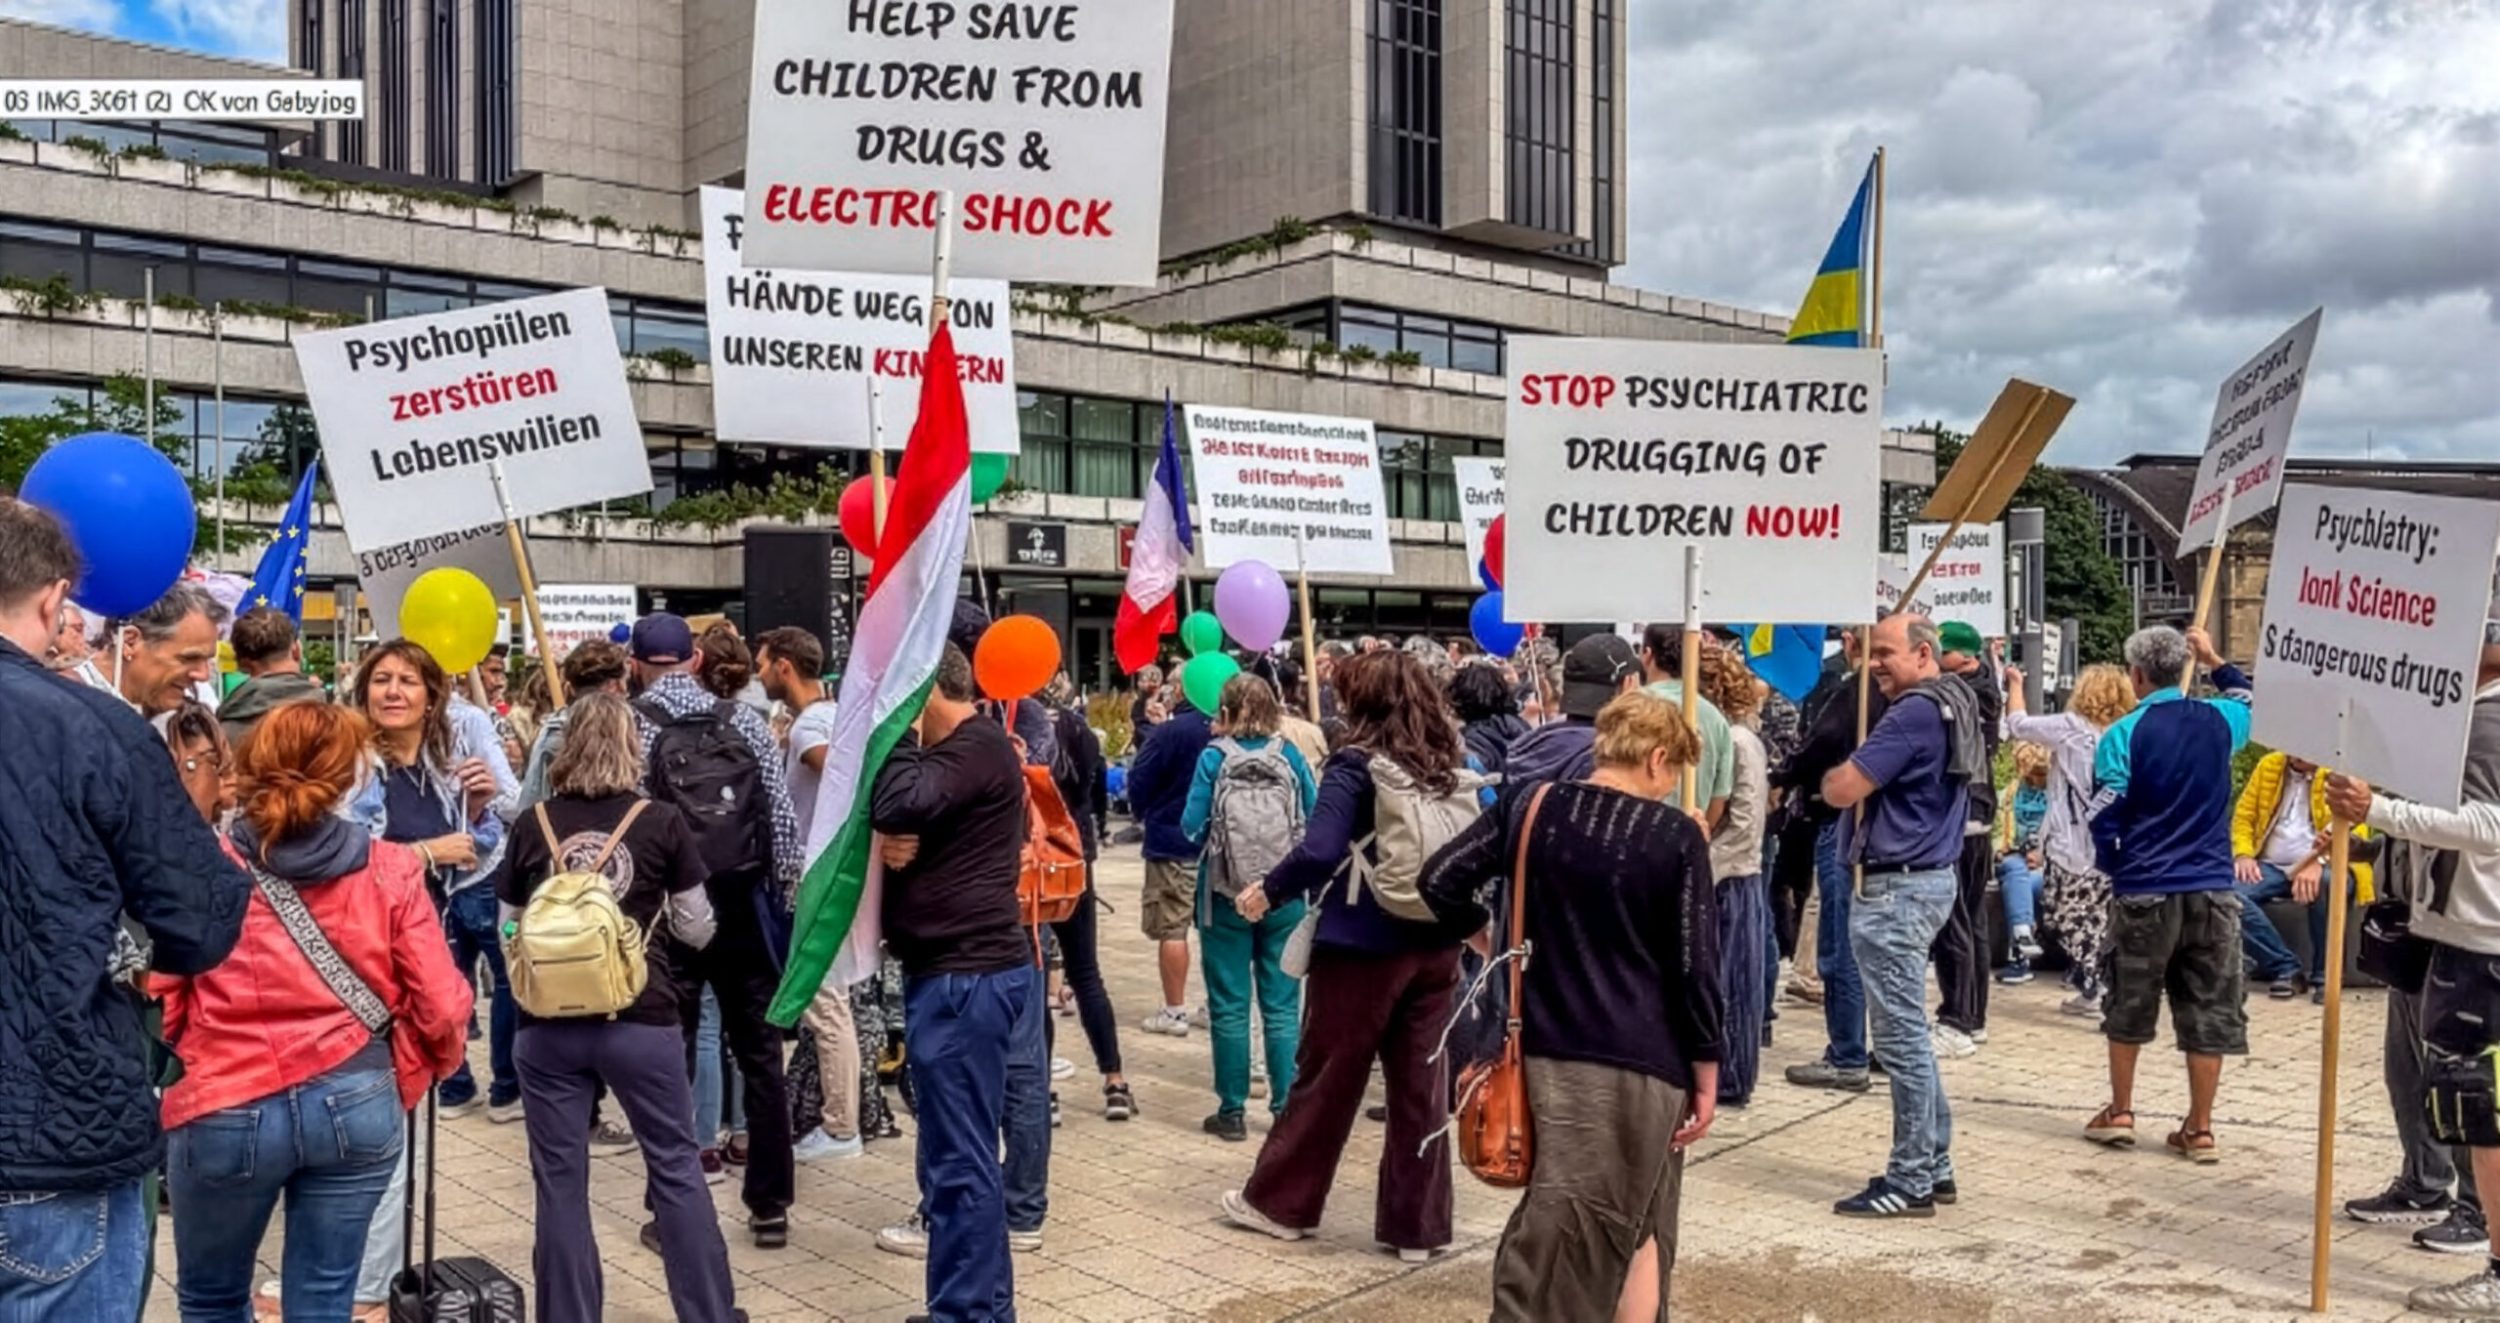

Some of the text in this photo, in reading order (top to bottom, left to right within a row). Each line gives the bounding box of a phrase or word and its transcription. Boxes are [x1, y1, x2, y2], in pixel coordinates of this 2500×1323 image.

[849, 0, 1078, 42] HELP SAVE
[774, 59, 1142, 109] CHILDREN FROM
[856, 125, 1051, 171] DRUGS &
[963, 193, 1113, 238] SHOCK
[727, 269, 993, 329] HÄNDE WEG ON
[723, 335, 1004, 384] UNSEREN KINERN
[389, 366, 558, 421] zerstören
[1520, 373, 1868, 414] STOP PSYCHIATRIC
[1564, 436, 1828, 478] DRUGGING OF
[1545, 501, 1840, 540] CHILDREN NOW!
[2347, 575, 2437, 627] Science
[2279, 628, 2388, 685] dangerous
[2391, 653, 2464, 707] drugs
